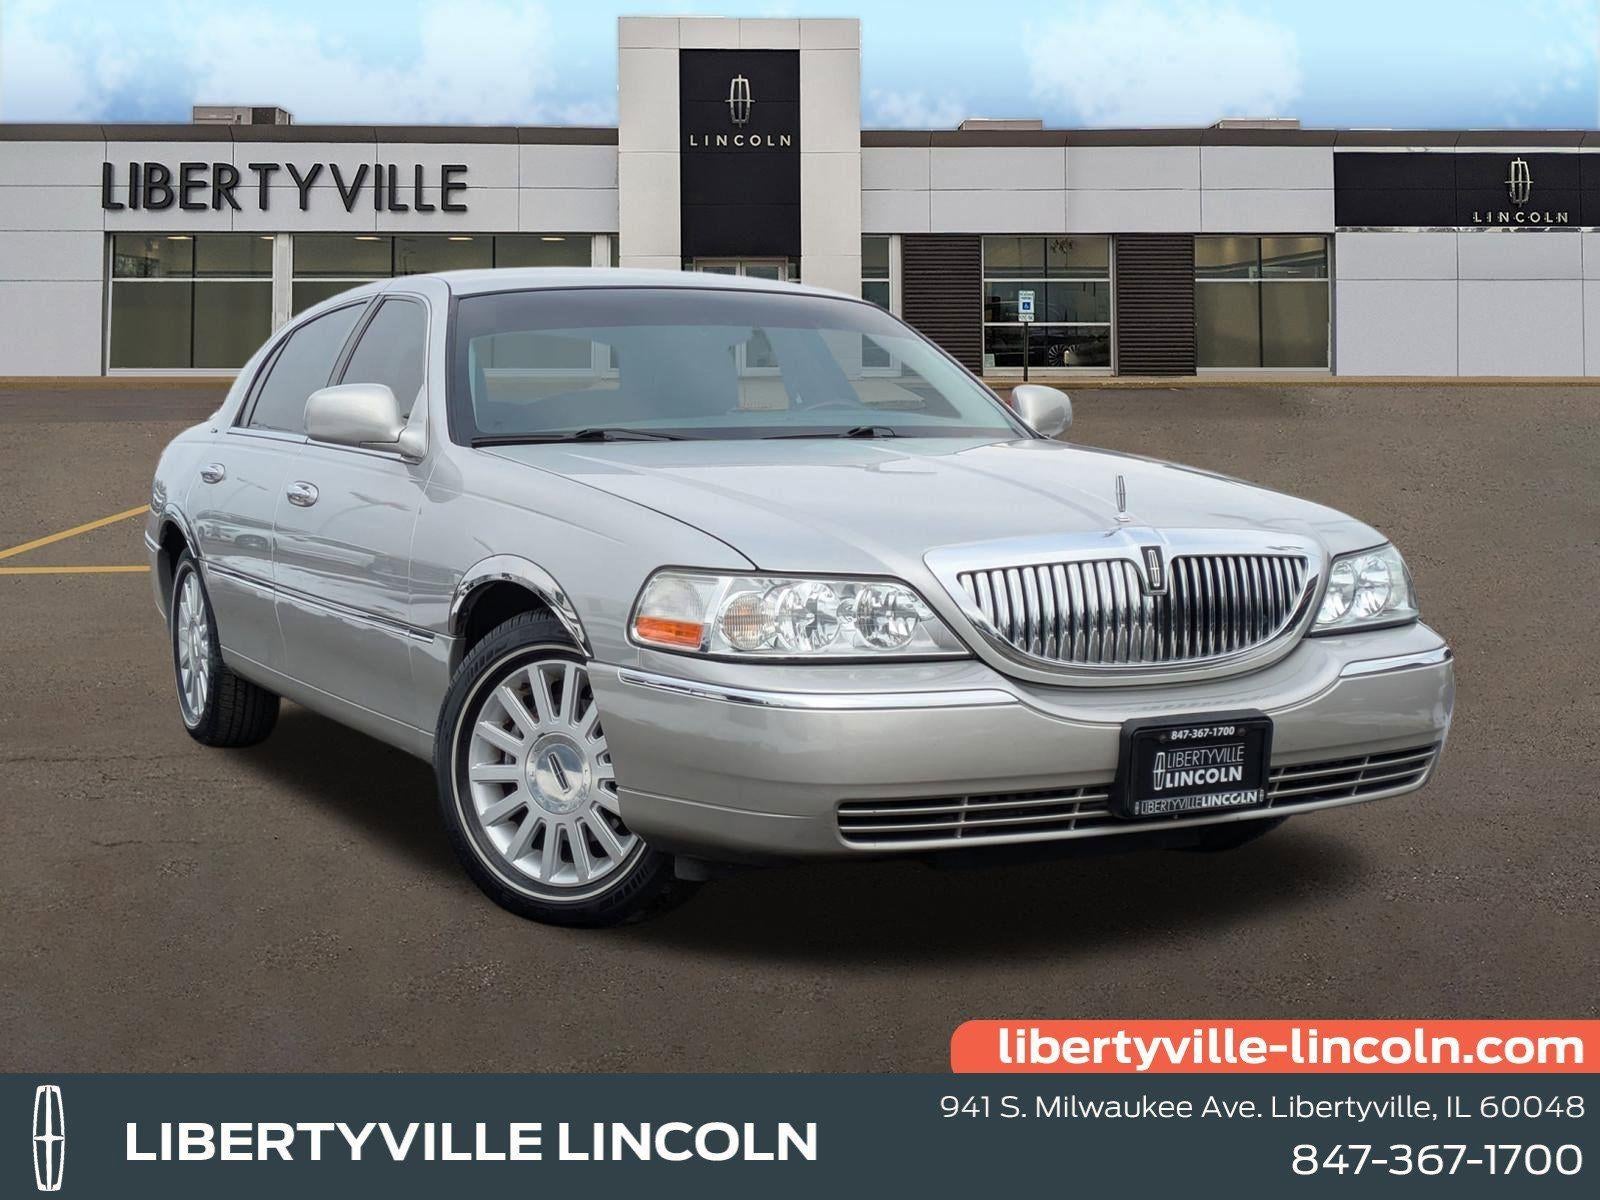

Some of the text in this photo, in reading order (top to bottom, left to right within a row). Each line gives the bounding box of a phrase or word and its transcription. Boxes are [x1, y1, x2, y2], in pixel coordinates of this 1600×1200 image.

[690, 134, 791, 147] LINCOLN
[102, 162, 469, 212] LIBERTYVILLE
[1472, 211, 1569, 224] LINCOLN
[1171, 726, 1235, 740] 847-367-1700
[1167, 745, 1245, 769] LIBERTYVILLE
[1165, 766, 1243, 788] LINCOLN
